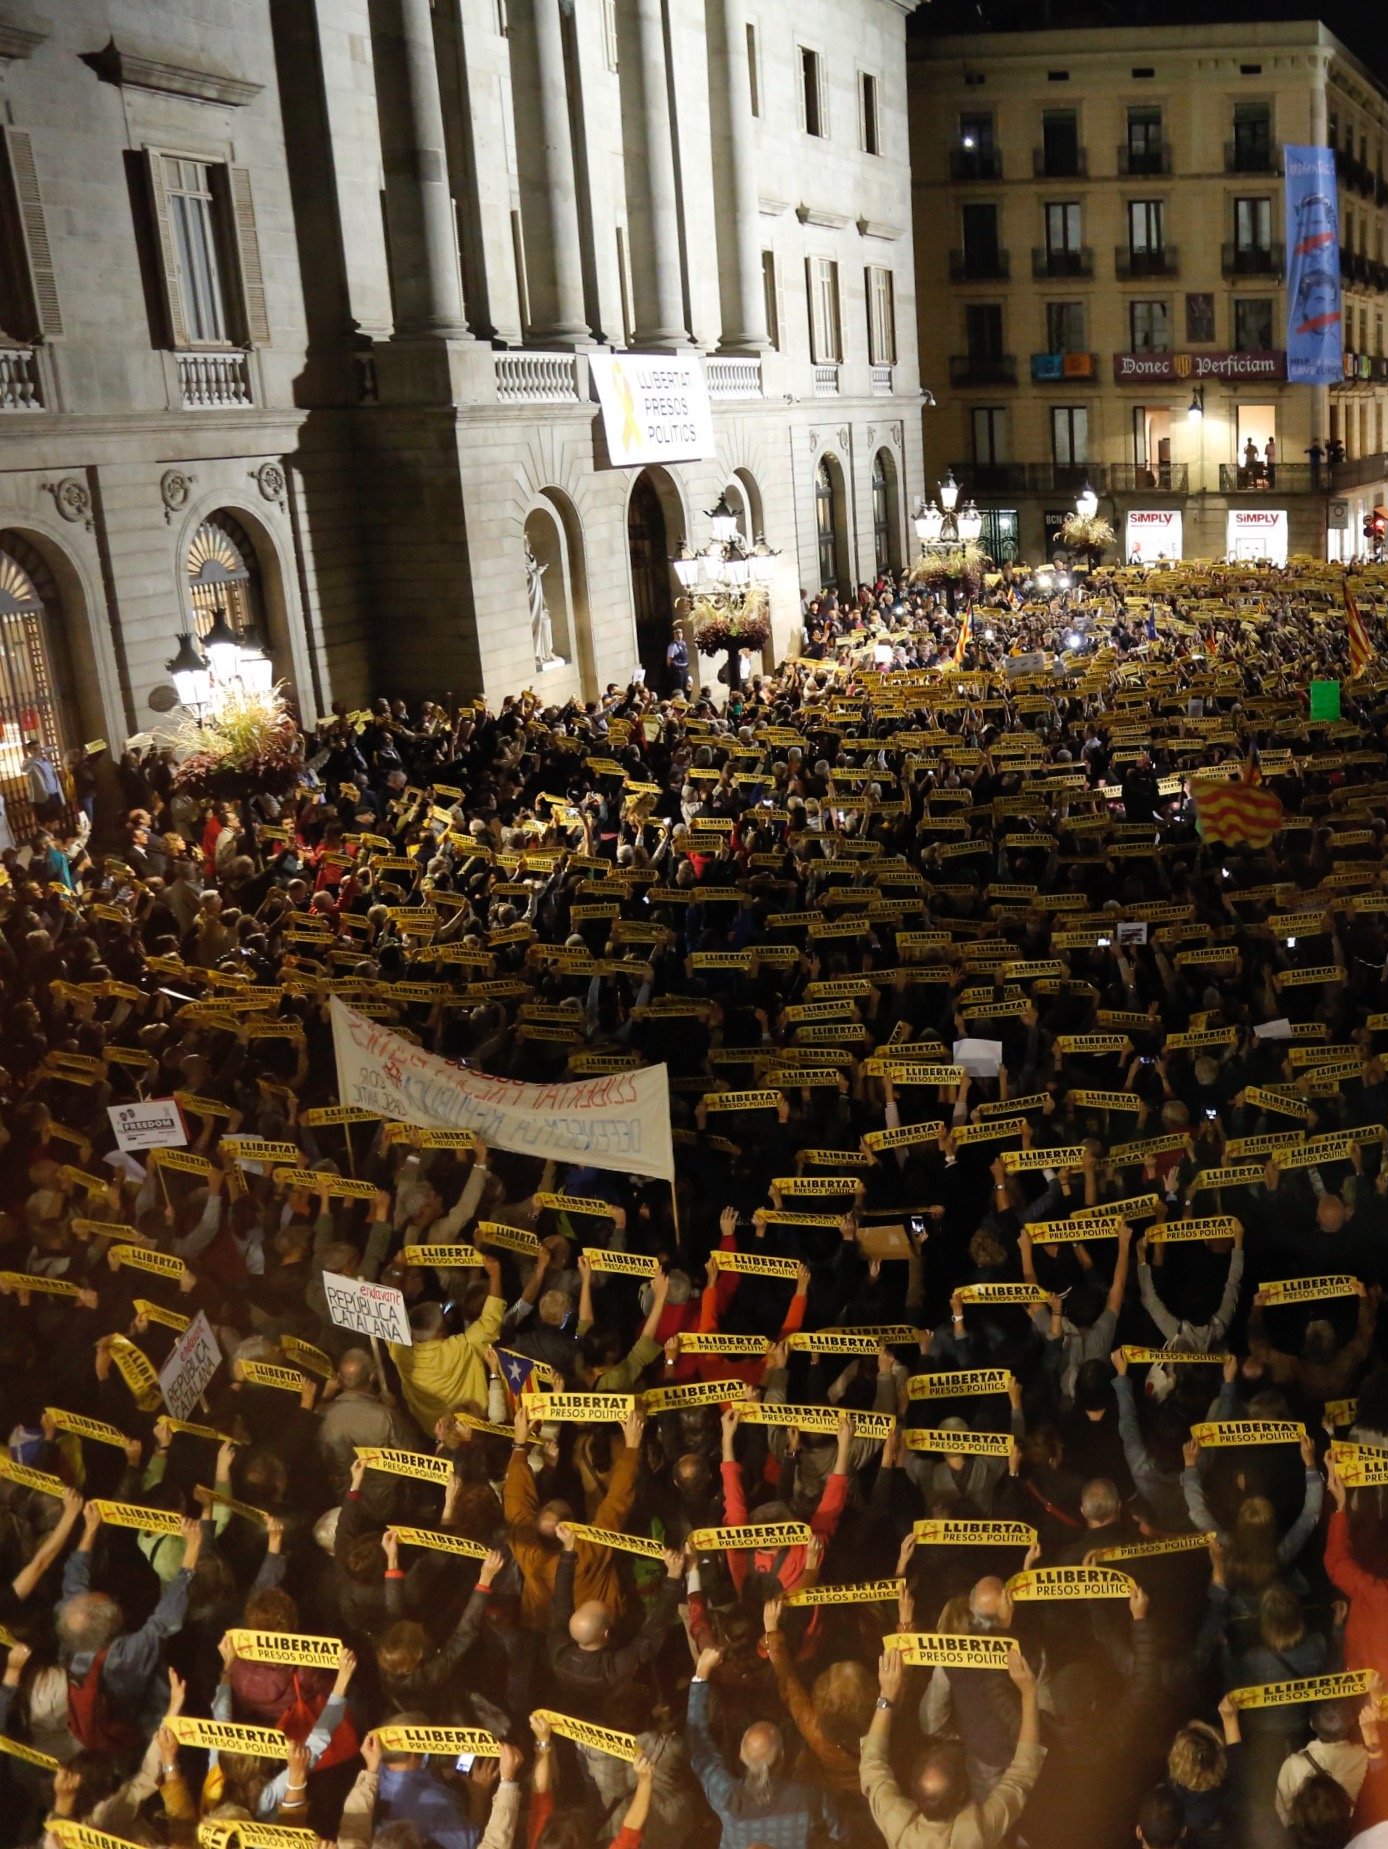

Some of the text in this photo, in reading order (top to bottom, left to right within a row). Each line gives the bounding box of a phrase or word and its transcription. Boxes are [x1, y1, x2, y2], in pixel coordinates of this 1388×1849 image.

[1121, 355, 1276, 376] Donec Perficiam
[636, 371, 691, 389] LLIBERTAT
[645, 398, 688, 416] PRESOS
[812, 1025, 864, 1036] LLIBERTAT
[1074, 1035, 1125, 1045] LLIBERTAT
[586, 1056, 641, 1067] LLIBERTAT
[905, 1066, 963, 1077] LLIBERTAT
[719, 1091, 779, 1103] LLIBERTAT
[1086, 1092, 1138, 1105] LLIBERTAT
[1259, 1089, 1309, 1114] LLIBERTAT
[124, 1120, 172, 1131] FREEDOM
[882, 1122, 940, 1140] LLIBERTAT
[967, 1120, 1023, 1135] LLIBERTAT
[1243, 1133, 1300, 1148] LLIBERTAT
[1325, 1126, 1381, 1142] LLIBERTAT
[240, 1141, 297, 1154] LLIBERTAT
[1301, 1141, 1348, 1158] LLIBERTAT
[1019, 1149, 1082, 1162] LLIBERTAT
[1207, 1166, 1266, 1180] LLIBERTAT
[794, 1180, 856, 1190] LLIBERTAT
[1091, 1198, 1154, 1217] LLIBERTAT
[1048, 1219, 1117, 1232] LLIBERTAT
[1167, 1218, 1233, 1232] LLIBERTAT
[1049, 1229, 1079, 1239] PRESOS
[1167, 1229, 1195, 1239] PRESOS
[132, 1250, 184, 1271] LLIBERTAT
[601, 1252, 654, 1269] LLIBERTAT
[734, 1254, 799, 1270] LLIBERTAT
[1282, 1277, 1351, 1292] LLIBERTAT
[360, 1284, 401, 1305] endavant
[1283, 1291, 1315, 1301] PRESOS
[332, 1305, 402, 1344] CATALANA
[929, 1371, 1004, 1386] LLIBERTAT
[664, 1381, 743, 1401] LLIBERTAT
[929, 1385, 964, 1395] PRESOS
[549, 1396, 628, 1409] LLIBERTAT
[551, 1408, 585, 1418] PRESOS
[761, 1405, 840, 1418] LLIBERTAT
[762, 1414, 796, 1423] PRESOS
[1219, 1424, 1299, 1435] LLIBERTAT
[930, 1431, 1008, 1444] LLIBERTAT
[1220, 1435, 1255, 1443] PRESOS
[929, 1440, 966, 1449] PRESOS
[382, 1450, 448, 1471] LLIBERTAT
[383, 1461, 412, 1475] PRESOS
[716, 1525, 806, 1540] LLIBERTAT
[944, 1522, 1031, 1535] LLIBERTAT
[719, 1537, 760, 1546] PRESOS
[943, 1533, 981, 1541] PRESOS
[1121, 1544, 1162, 1556] PRESOS
[1036, 1570, 1128, 1583] LLIBERTAT
[805, 1581, 898, 1595] LLIBERTAT
[1037, 1583, 1081, 1596] PRESOS
[806, 1593, 849, 1603] PRESOS
[256, 1636, 339, 1655] LLIBERTAT
[918, 1637, 1013, 1653] LLIBERTAT
[258, 1649, 295, 1661] PRESOS
[920, 1651, 963, 1664] PRESOS
[1263, 1673, 1365, 1694] LLIBERTAT
[1264, 1689, 1310, 1703] PRESOS
[198, 1724, 286, 1746] LLIBERTAT
[202, 1735, 241, 1748] PRESOS
[409, 1742, 451, 1752] PRESOS
[245, 1835, 284, 1848] PRESOS
